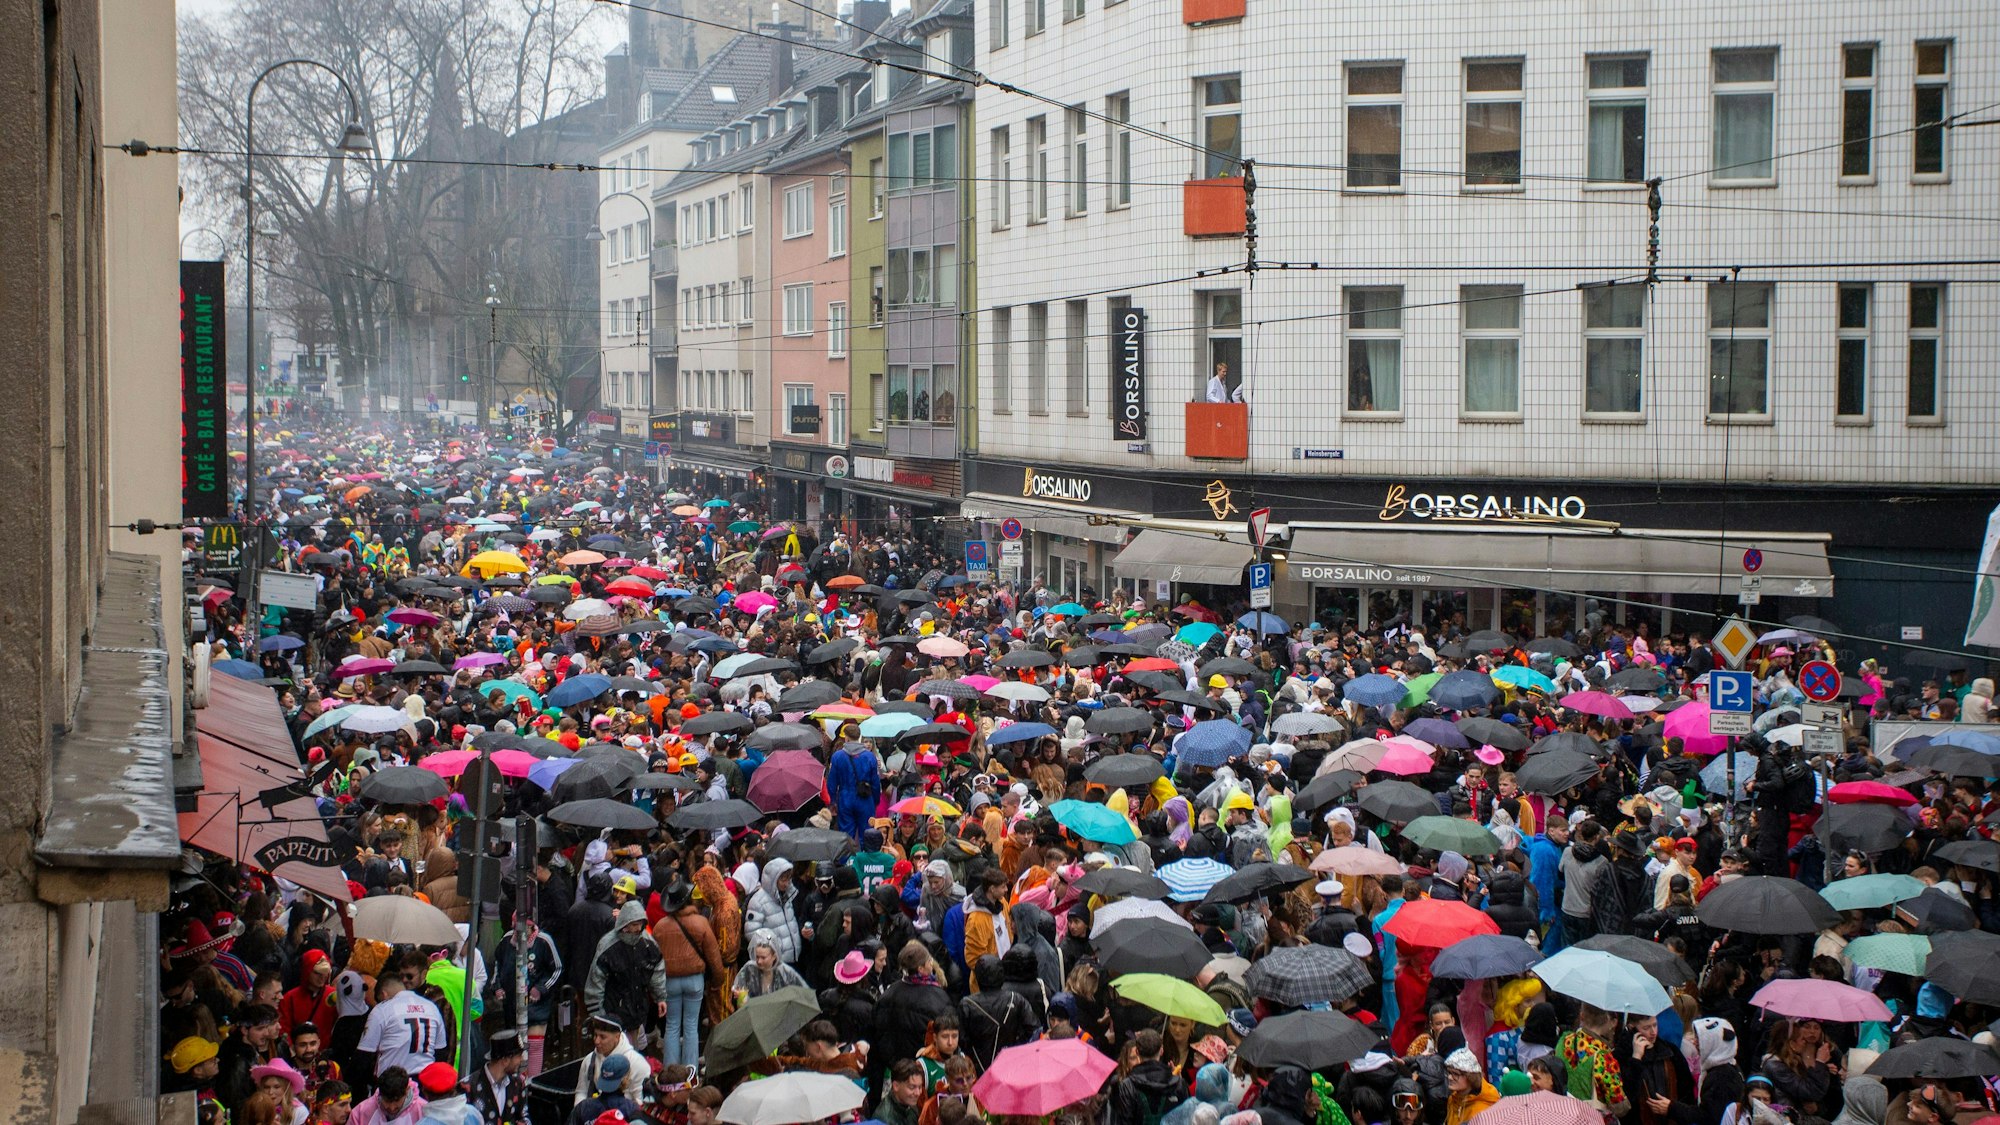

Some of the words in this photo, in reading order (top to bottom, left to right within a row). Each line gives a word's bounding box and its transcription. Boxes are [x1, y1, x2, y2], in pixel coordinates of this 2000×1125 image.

[195, 294, 214, 394] RESTAURANT
[1120, 313, 1140, 437] BORSALINO
[197, 409, 215, 438] BAR
[195, 454, 215, 492] CAFÉ
[1023, 467, 1091, 501] BORSALINO
[1379, 484, 1586, 521] BORSALINO
[969, 562, 986, 570] TAXI
[1255, 567, 1266, 586] P
[1301, 567, 1392, 581] BORSALINO
[1396, 574, 1411, 582] seit
[1717, 676, 1739, 706] P
[265, 842, 338, 864] PAPELIT
[864, 865, 885, 873] MARINO
[1676, 915, 1699, 925] SWAT
[407, 1005, 425, 1013] JONES
[404, 1017, 430, 1054] 11
